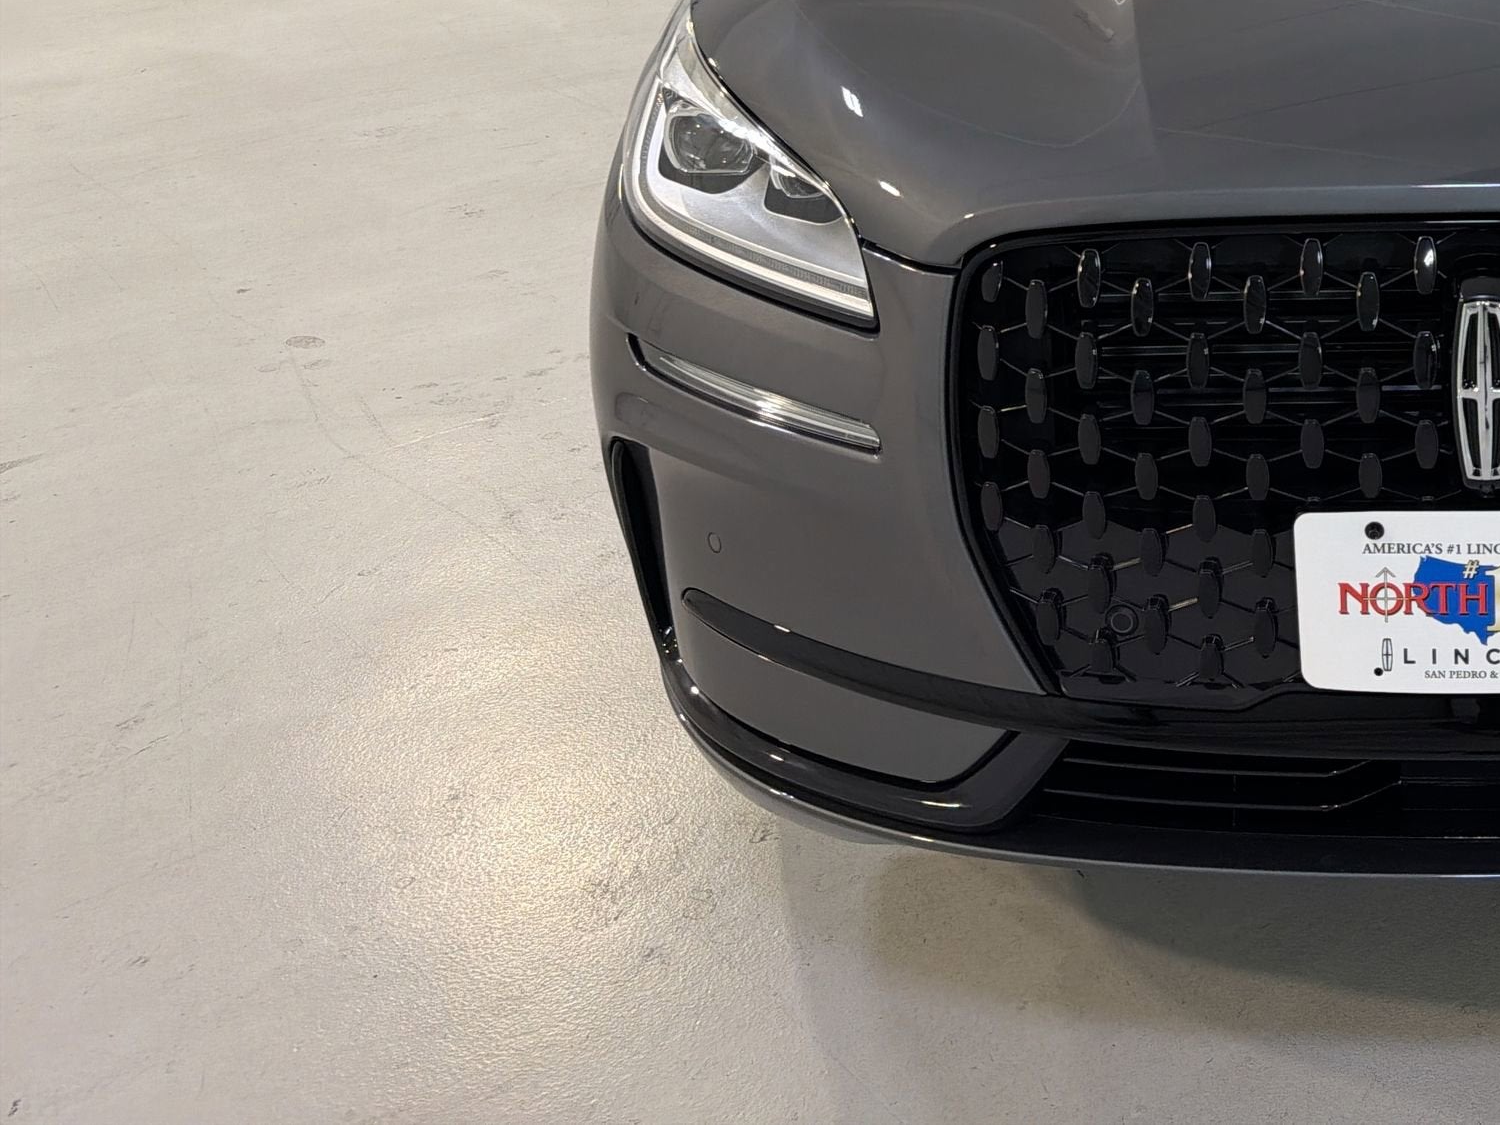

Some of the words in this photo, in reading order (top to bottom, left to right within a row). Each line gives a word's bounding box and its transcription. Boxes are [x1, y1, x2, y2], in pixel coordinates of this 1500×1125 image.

[1362, 543, 1443, 555] AMERICA'S
[1447, 543, 1462, 555] #1
[1337, 582, 1488, 615] NORTH
[1424, 670, 1446, 679] SAN
[1449, 670, 1487, 679] PEDRO
[1490, 670, 1498, 679] &
